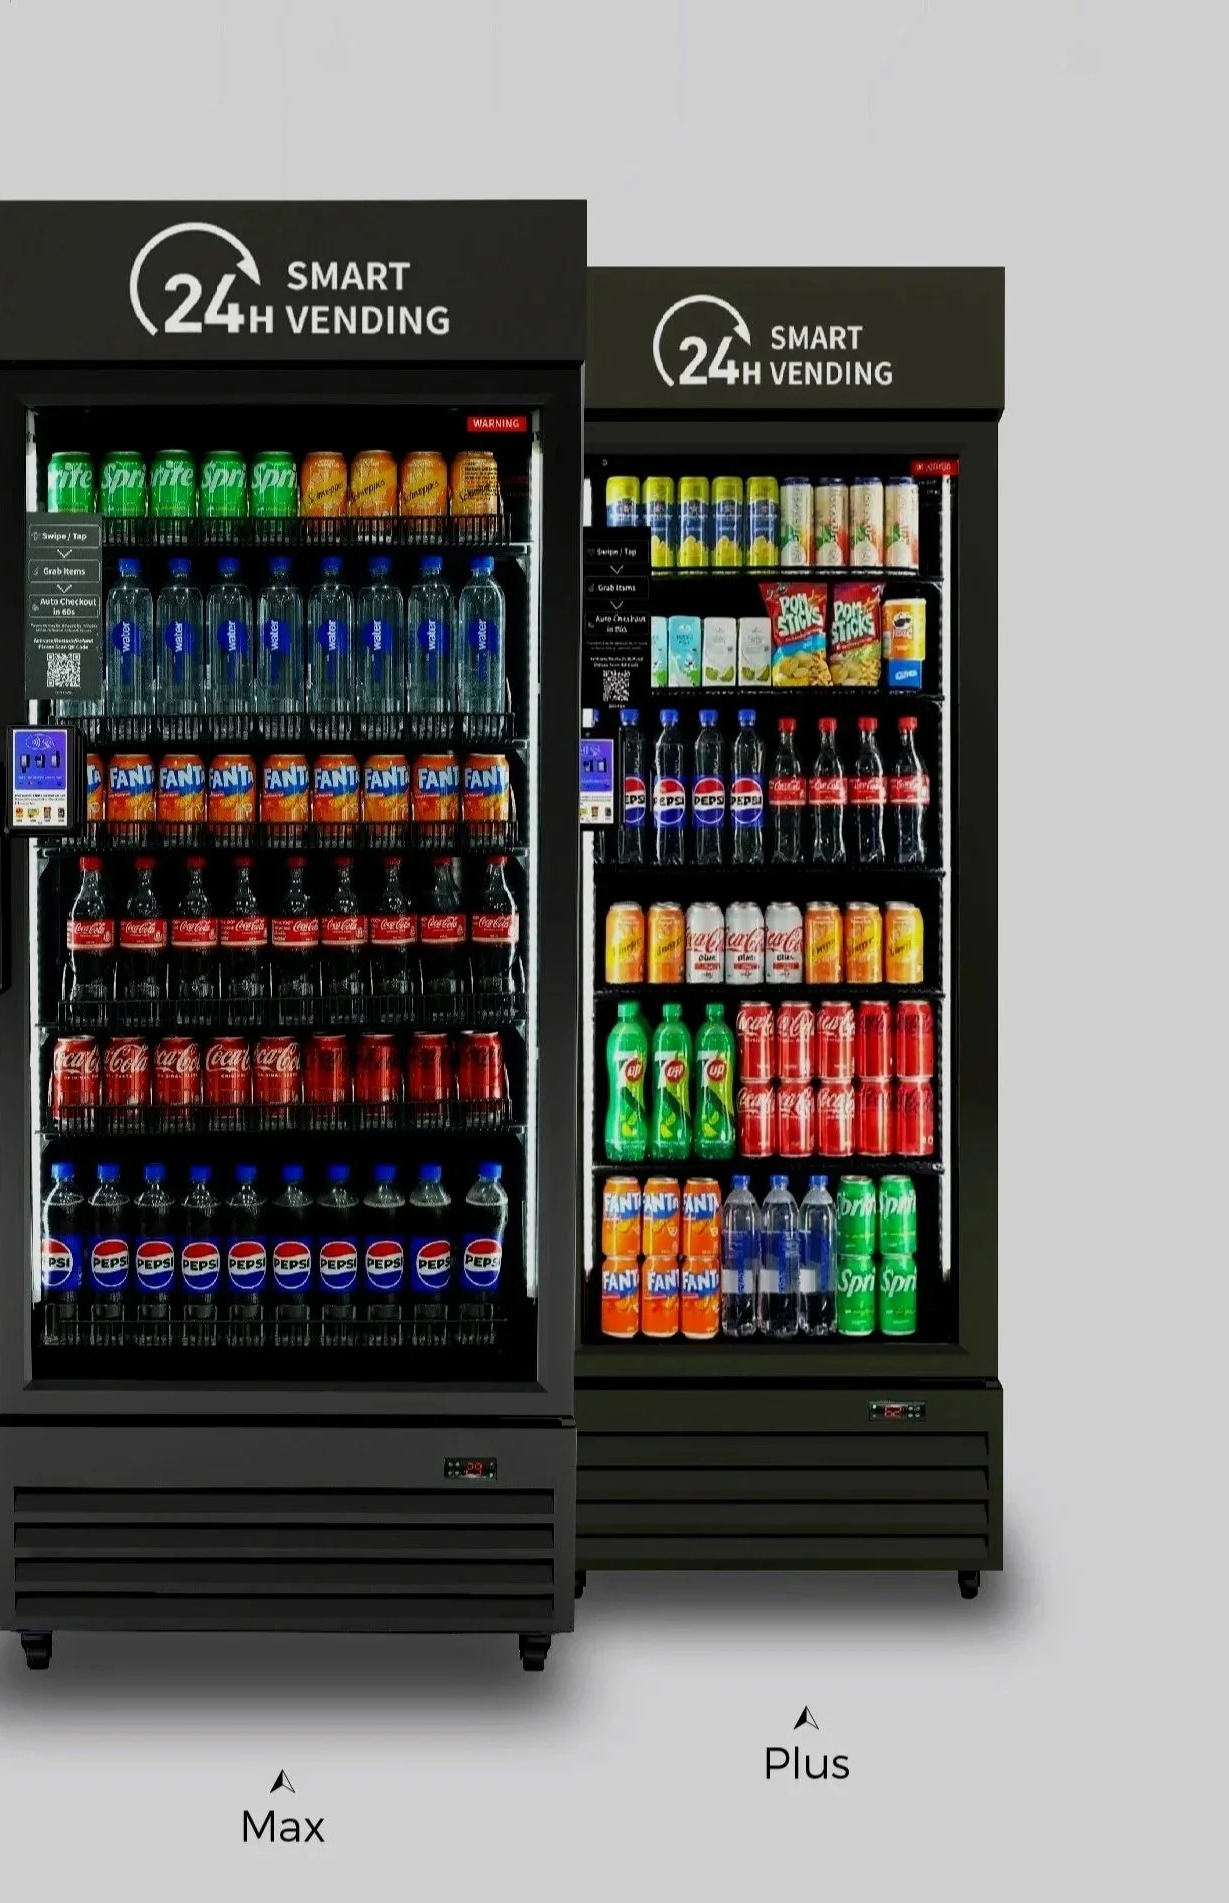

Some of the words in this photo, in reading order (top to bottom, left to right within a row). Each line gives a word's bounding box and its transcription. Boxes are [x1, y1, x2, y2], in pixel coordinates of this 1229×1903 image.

[164, 273, 274, 334] 24H
[286, 261, 411, 291] SMART
[285, 305, 450, 336] VENDING
[678, 335, 762, 386] 24H
[770, 325, 864, 351] SMART
[769, 360, 894, 386] VENDING
[472, 418, 521, 429] WARNING
[48, 462, 94, 489] rite
[101, 463, 147, 494] Spri
[150, 459, 195, 488] rite
[200, 460, 247, 494] Spri
[251, 461, 298, 494] Spri
[41, 532, 66, 542] Swipe
[73, 532, 87, 543] Tap
[43, 567, 62, 576] Grab
[63, 567, 86, 576] Items
[39, 597, 59, 606] Auto
[60, 597, 97, 606] Checkout
[597, 583, 615, 592] Grab
[62, 607, 76, 616] 60s
[122, 621, 131, 652] water
[175, 621, 183, 652] water
[227, 620, 237, 651] water
[270, 619, 279, 651] water
[327, 619, 337, 651] water
[372, 619, 382, 651] water
[427, 619, 437, 651] water
[478, 618, 487, 650] water
[418, 765, 460, 790] FANT
[625, 794, 645, 806] EPS
[48, 1257, 71, 1268] PSI
[419, 1257, 450, 1270] PEPS
[837, 1266, 876, 1298] Spri
[880, 1266, 917, 1298] Spri
